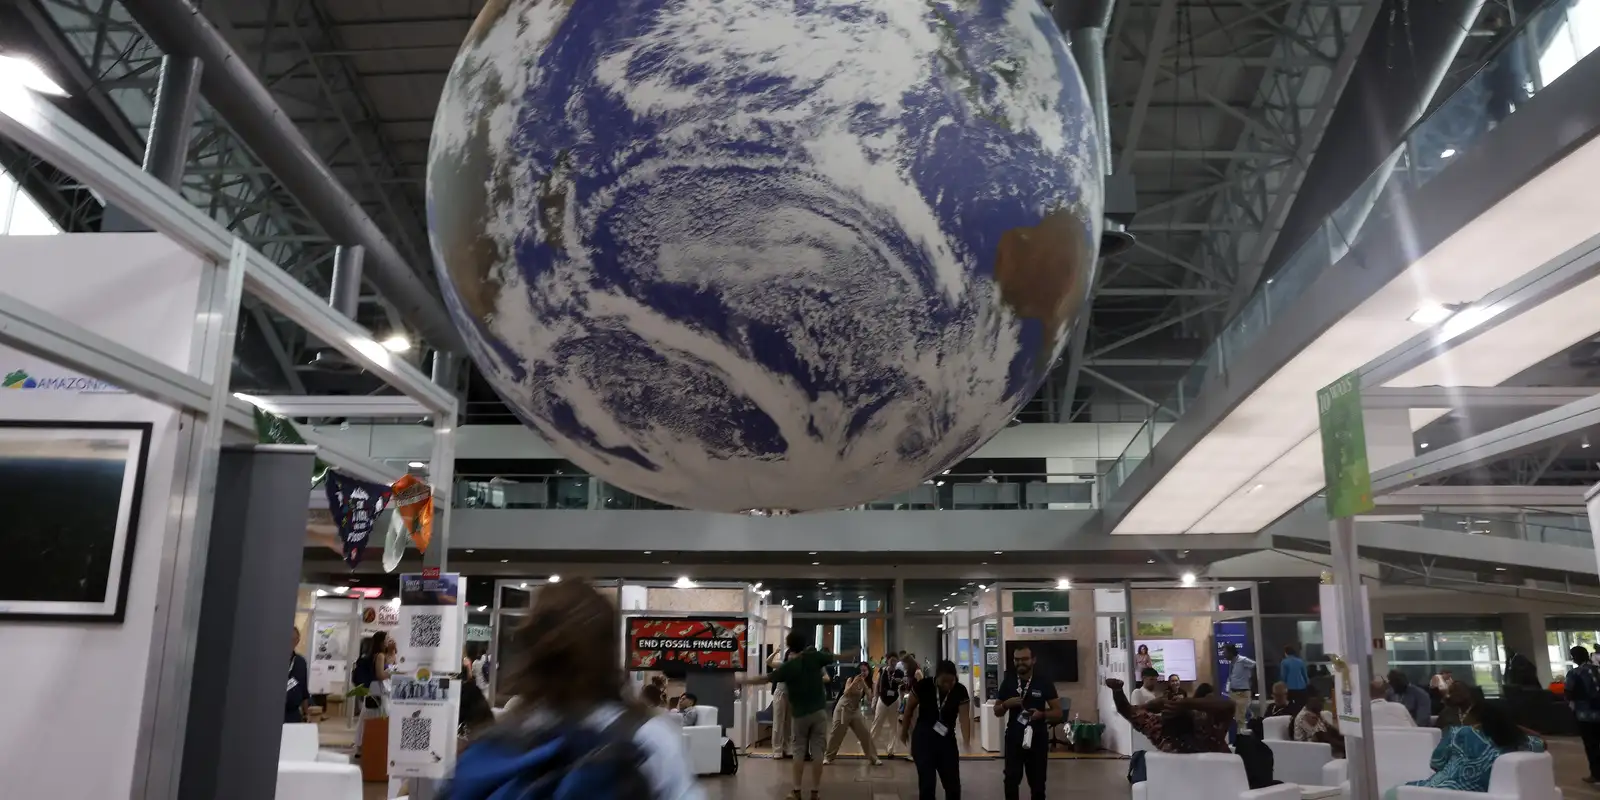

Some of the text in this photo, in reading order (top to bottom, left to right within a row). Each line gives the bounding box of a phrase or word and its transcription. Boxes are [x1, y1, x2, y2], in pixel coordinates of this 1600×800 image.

[639, 639, 733, 649] END FOSSIL FINANCE
